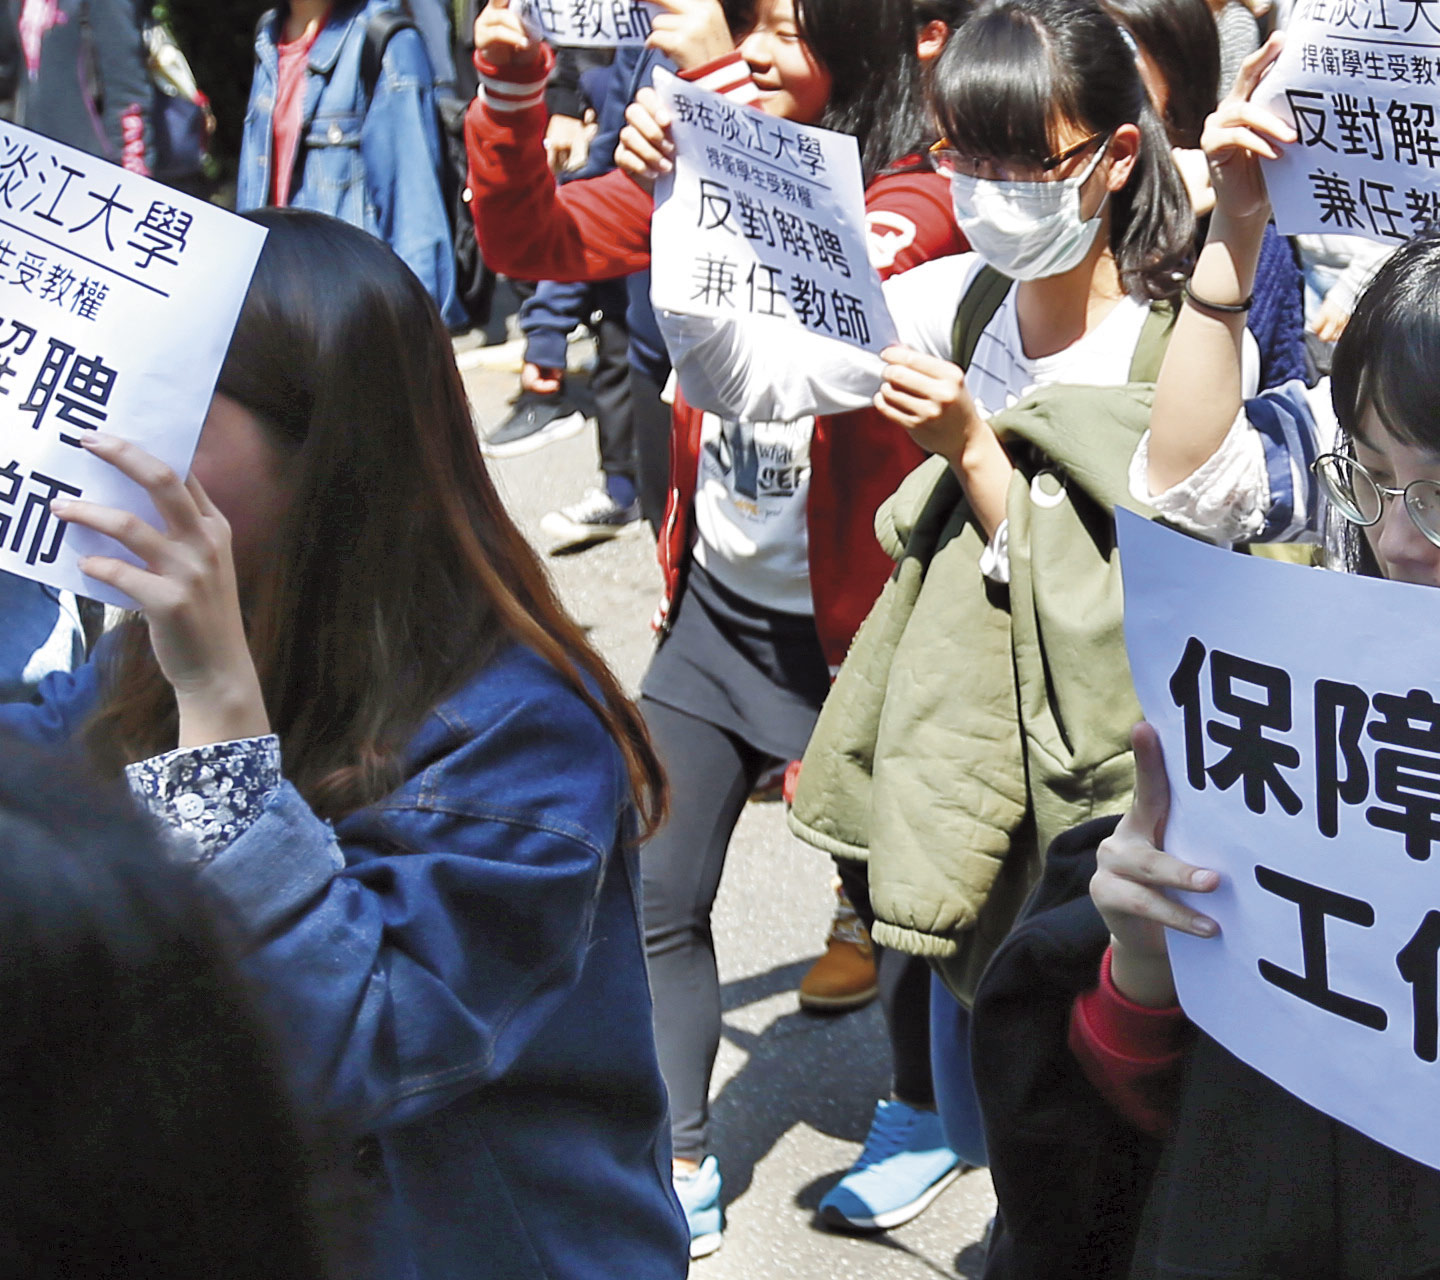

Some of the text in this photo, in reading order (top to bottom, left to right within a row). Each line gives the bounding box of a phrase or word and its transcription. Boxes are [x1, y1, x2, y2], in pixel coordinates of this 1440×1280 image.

[673, 93, 826, 177] 我在淡江大學
[698, 178, 851, 279] 反對解聘
[690, 253, 871, 346] 兼任教師
